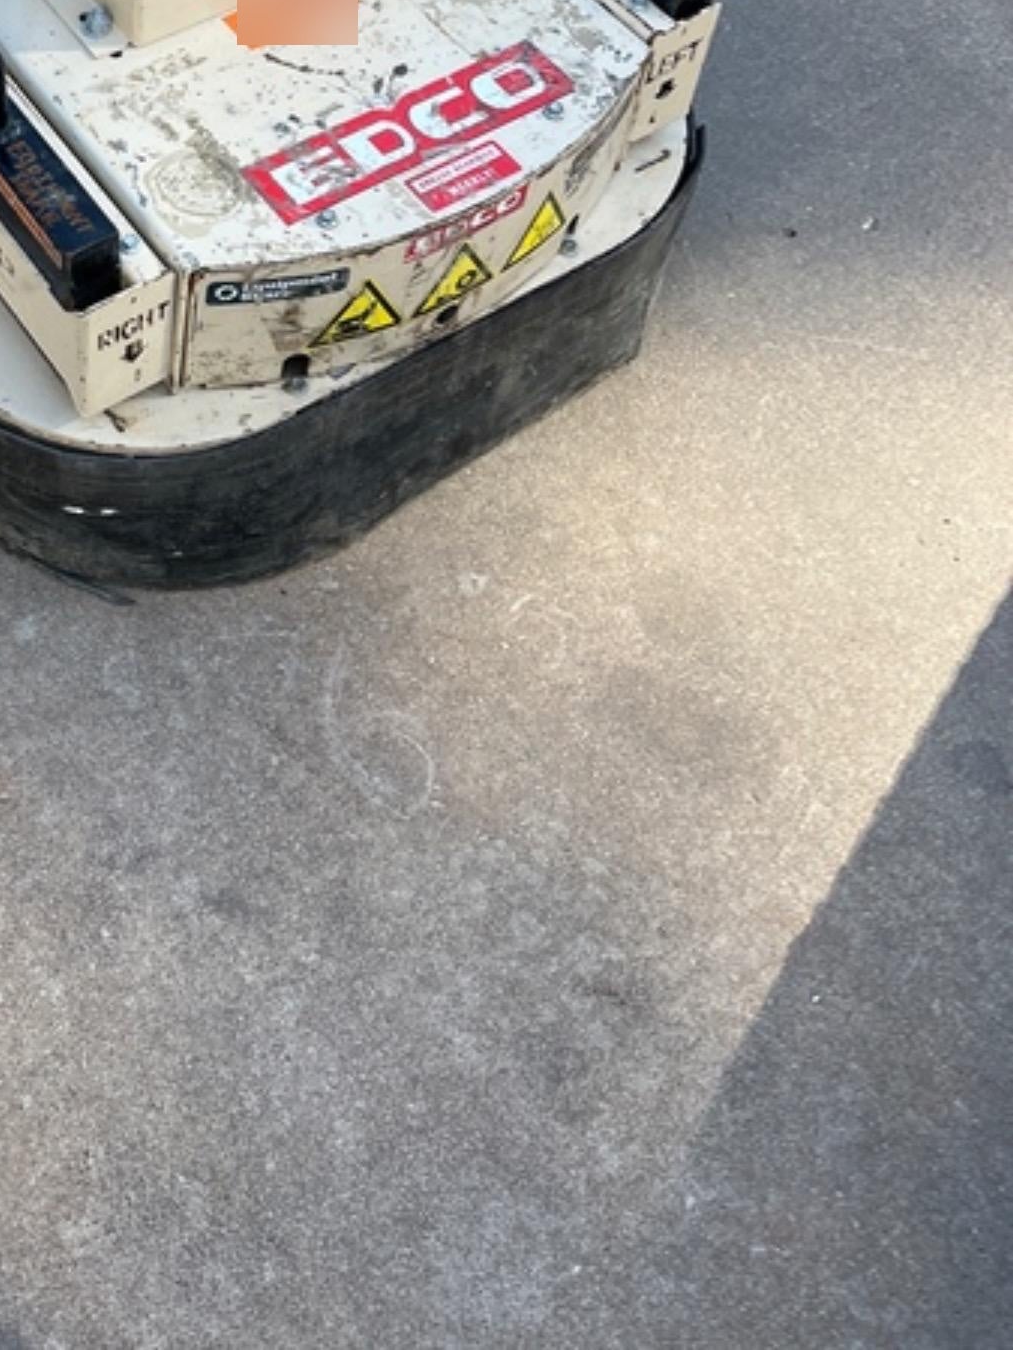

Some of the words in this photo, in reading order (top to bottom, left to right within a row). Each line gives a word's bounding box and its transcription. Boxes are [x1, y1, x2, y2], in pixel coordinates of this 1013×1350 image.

[644, 35, 705, 85] LEFT
[270, 59, 548, 207] EDCO
[97, 299, 171, 352] RIGHT
